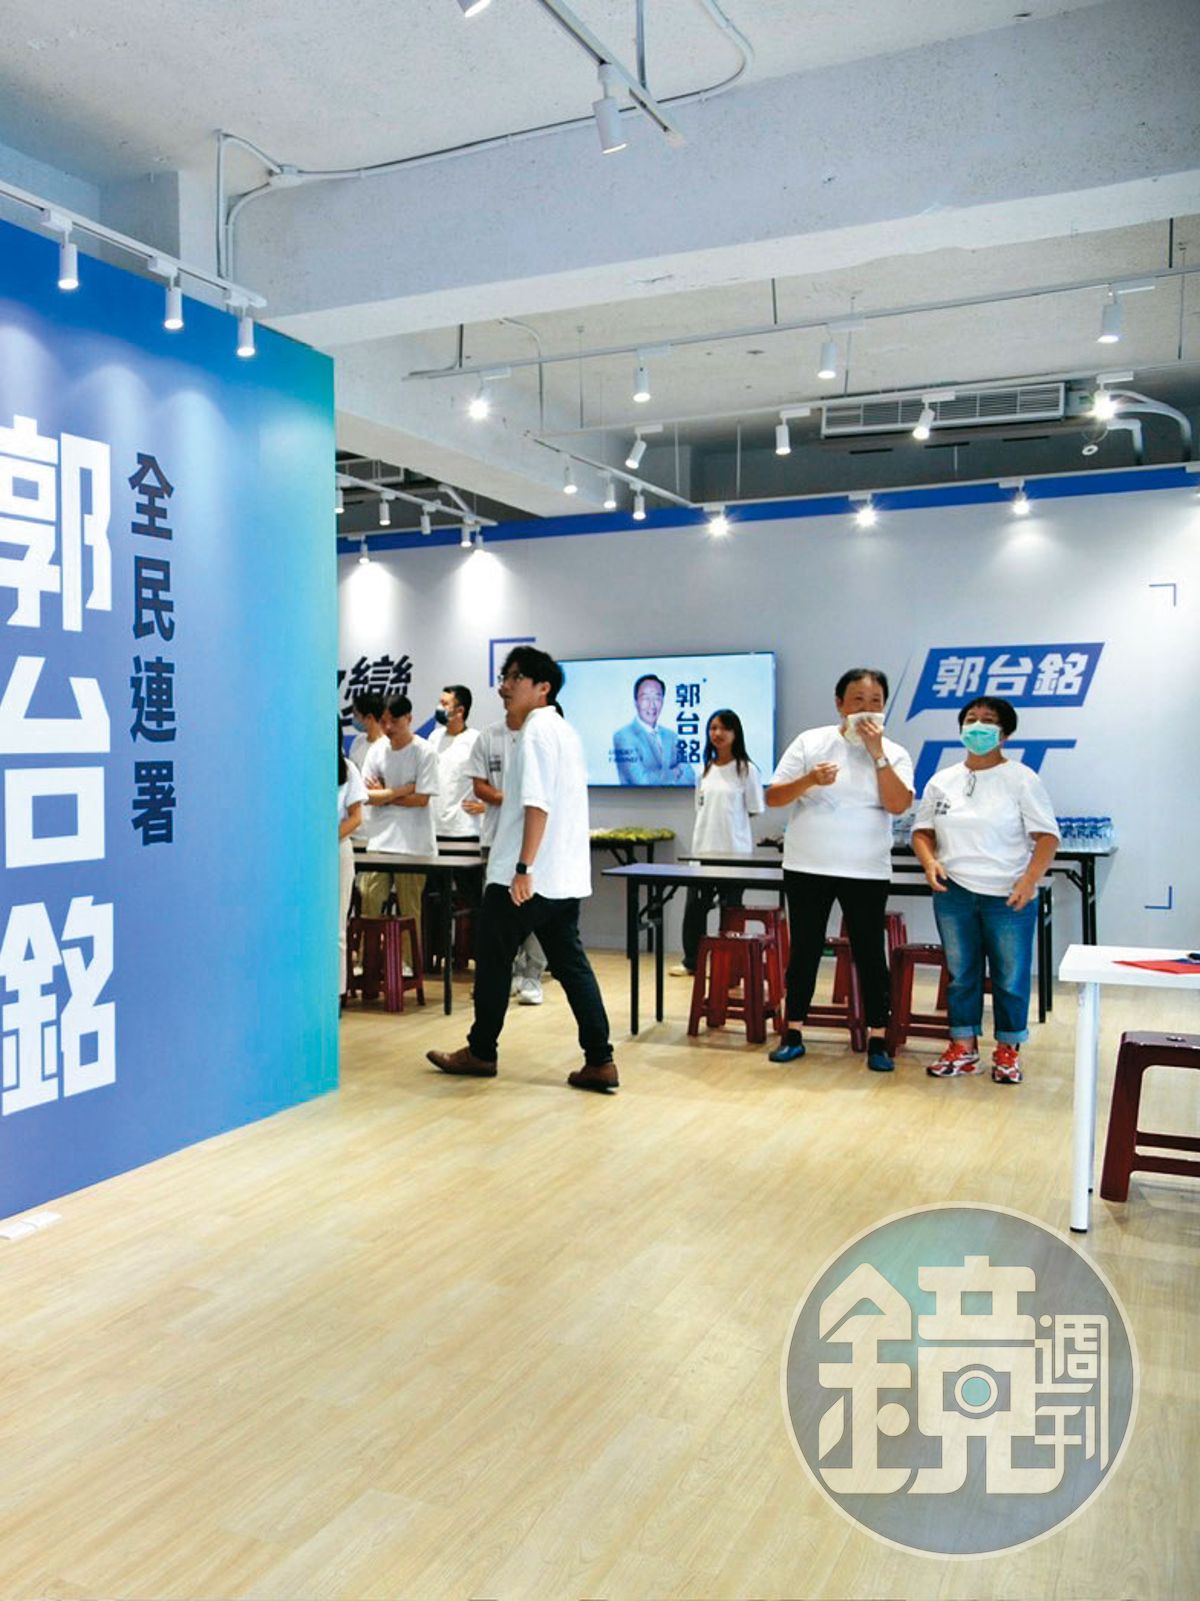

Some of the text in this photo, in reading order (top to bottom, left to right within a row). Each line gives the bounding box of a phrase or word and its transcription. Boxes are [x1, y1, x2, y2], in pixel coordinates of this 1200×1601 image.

[128, 452, 177, 846] 全民連署
[932, 652, 1089, 698] 郭台銘
[675, 683, 701, 763] 郭台銘
